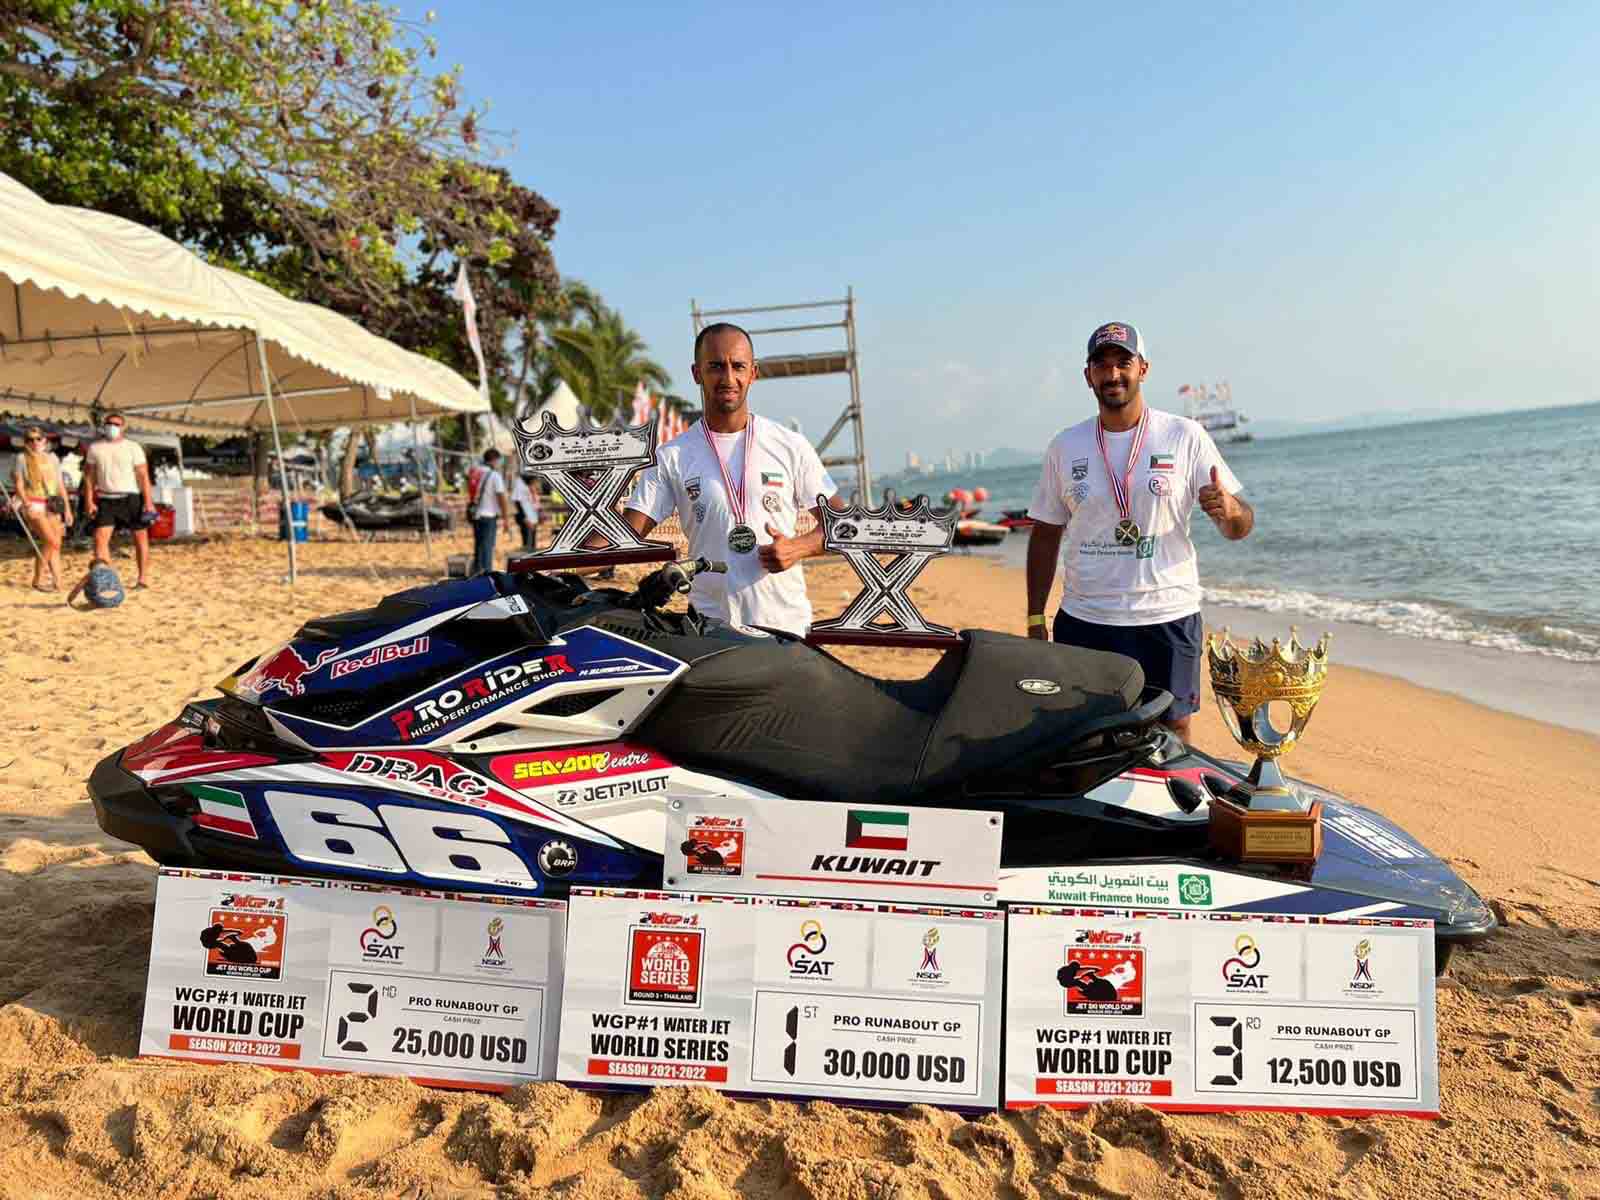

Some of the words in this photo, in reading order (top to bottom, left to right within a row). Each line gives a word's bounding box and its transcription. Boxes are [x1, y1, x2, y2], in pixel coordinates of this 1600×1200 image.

[331, 648, 380, 679] Red
[380, 636, 430, 663] Bull
[411, 721, 440, 739] HIGH
[443, 680, 530, 725] PERFORMANCE
[533, 669, 565, 683] SHOP
[596, 752, 649, 773] Centre
[345, 754, 488, 796] DRAG
[583, 775, 670, 802] JETPILOT
[264, 791, 539, 889] 66
[553, 858, 576, 868] BRP
[811, 855, 941, 877] KUWAIT
[1048, 871, 1097, 887] الكويتي
[1100, 874, 1144, 889] التمويل
[1146, 876, 1169, 891] بيت
[1048, 889, 1087, 901] Kuwait
[1090, 891, 1133, 904] Finance
[1136, 894, 1170, 905] House
[363, 944, 405, 959] SAT
[641, 957, 690, 972] WORLD
[790, 960, 834, 975] SAT
[640, 971, 690, 985] SERIES
[1226, 974, 1269, 988] SAT
[175, 987, 238, 1005] WGP#1
[243, 991, 285, 1009] WATER
[287, 995, 307, 1010] JET
[633, 991, 655, 999] ROUND
[408, 996, 432, 1007] PRO
[435, 998, 499, 1013] RUNABOUT
[502, 1005, 519, 1015] GP
[173, 1005, 253, 1035] WORLD
[259, 1011, 304, 1039] CUP
[337, 982, 378, 1052] 2
[382, 985, 397, 999] ND
[443, 1015, 461, 1023] CASH
[462, 1017, 481, 1025] PRIZE
[592, 1013, 659, 1030] WGP#1
[664, 1016, 707, 1033] WATER
[710, 1020, 731, 1035] JET
[833, 1015, 861, 1026] PRO
[865, 1016, 939, 1031] RUNABOUT
[943, 1022, 961, 1032] GP
[876, 1035, 896, 1043] CASH
[897, 1036, 917, 1044] PRIZE
[1036, 1029, 1101, 1044] WGP#1
[1106, 1030, 1150, 1045] WATER
[1153, 1031, 1173, 1045] JET
[1277, 1025, 1301, 1035] PRO
[1305, 1026, 1371, 1038] RUNABOUT
[1375, 1028, 1391, 1038] GP
[189, 1038, 226, 1052] SEASON
[228, 1040, 281, 1056] 2021-2022
[391, 1027, 474, 1059] 25,000
[480, 1035, 527, 1064] USD
[591, 1033, 659, 1058] WORLD
[663, 1037, 729, 1062] SERIES
[784, 1005, 799, 1077] 1
[803, 1006, 818, 1018] ST
[1314, 1042, 1333, 1050] CASH
[1334, 1043, 1353, 1051] PRIZE
[1209, 1016, 1243, 1086] 3
[1246, 1016, 1261, 1030] RD
[824, 1048, 910, 1080] 30,000
[916, 1054, 966, 1083] USD
[1036, 1047, 1119, 1074] WORLD
[1125, 1049, 1172, 1075] CUP
[608, 1062, 649, 1075] SEASON
[651, 1064, 707, 1079] 2021-2022
[1266, 1057, 1347, 1087] 12,500
[1353, 1060, 1401, 1088] USD
[1055, 1079, 1096, 1093] SEASON
[1097, 1080, 1152, 1094] 2021-2022
